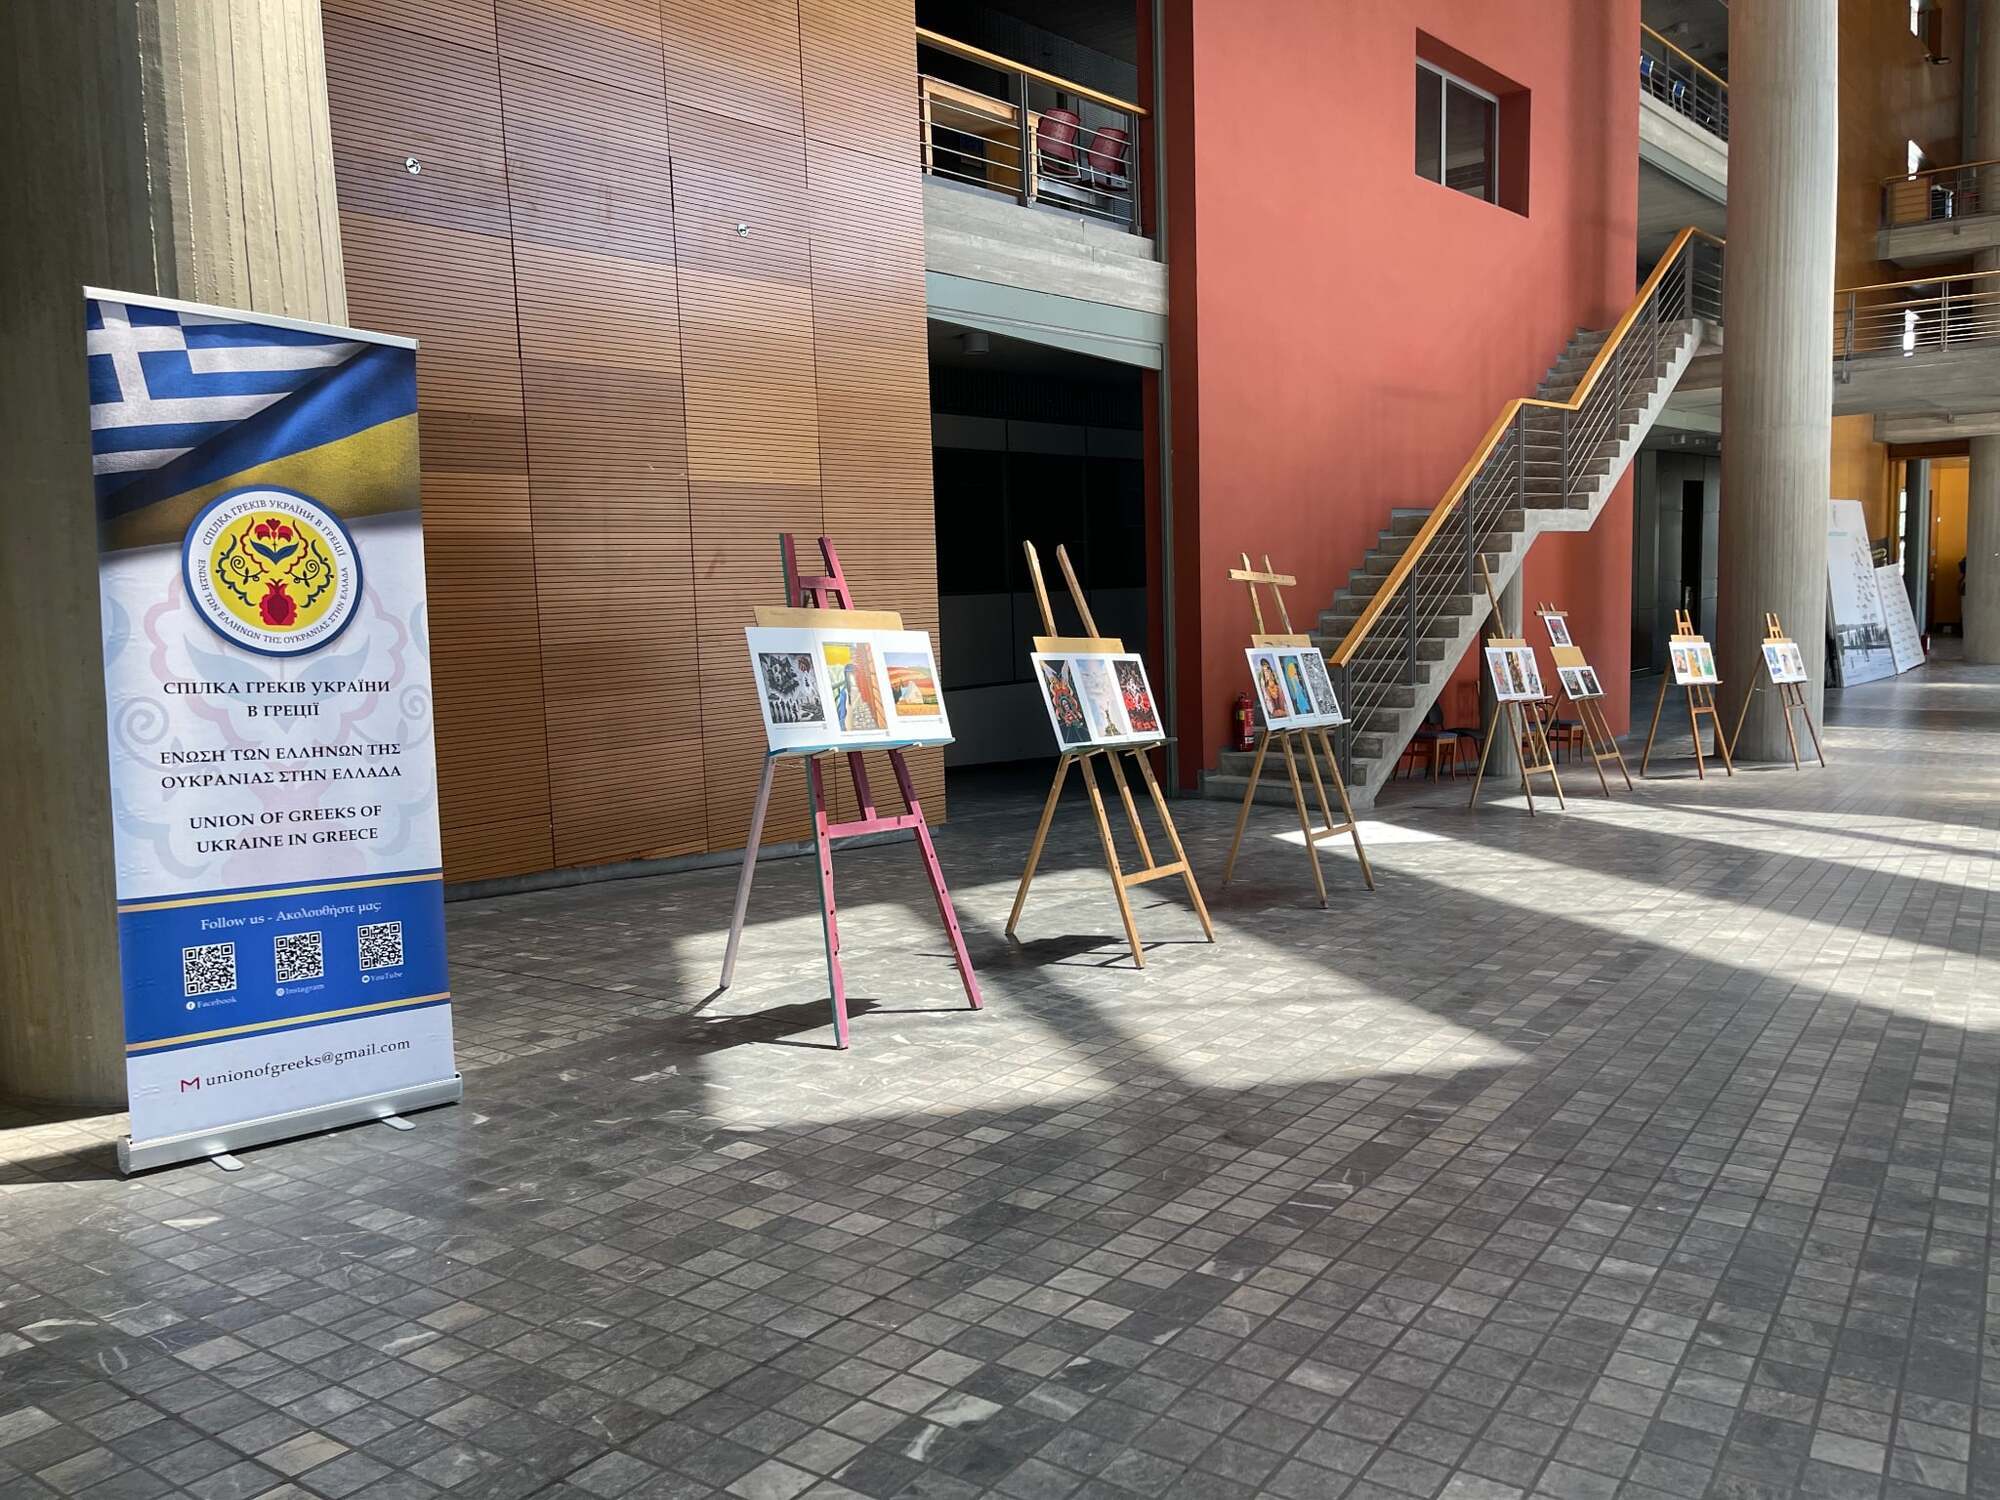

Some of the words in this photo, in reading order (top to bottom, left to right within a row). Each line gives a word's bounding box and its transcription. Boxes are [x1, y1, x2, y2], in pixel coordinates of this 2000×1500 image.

[203, 511, 233, 546] СПІЛКА
[232, 500, 267, 516] ГРЕКІВ
[269, 500, 315, 522] УКРАЇНИ
[315, 519, 322, 527] В
[198, 559, 210, 592] ΕΝΩΣΗ
[205, 592, 221, 612] ΤΩΝ
[217, 612, 261, 641] ΕΛΛΗΝΩΝ
[263, 634, 282, 644] ΤΗΣ
[283, 622, 330, 644] ΟΥΚΡΑΝΙΑΣ
[328, 600, 345, 623] ΣΤΗΝ
[342, 567, 350, 600] ΕΛΛΑΔΑ
[163, 681, 240, 695] СПІЛКА
[246, 681, 306, 694] ГРЕКІВ
[311, 680, 390, 696] УКРАЇНИ
[248, 704, 258, 717] В
[263, 703, 320, 719] ГРЕЦІЇ
[160, 750, 226, 765] ΕΝΩΣΗ
[231, 748, 270, 761] ΤΩΝ
[276, 744, 363, 760] ΕΛΛΗΝΩΝ
[367, 743, 401, 756] ΤΗΣ
[161, 771, 274, 789] ΟΥΚΡΑΝΙΑΣ
[279, 768, 327, 783] ΣΤΗΝ
[333, 765, 401, 780] ΕΛΛΑΔΑ
[190, 813, 255, 829] UNION
[260, 811, 284, 824] OF
[288, 806, 356, 822] GREEKS
[360, 805, 382, 817] OF
[197, 835, 284, 853] UKRAINE
[289, 833, 307, 846] IN
[312, 828, 379, 844] GREECE
[200, 917, 246, 931] Follow
[249, 914, 265, 925] us
[275, 904, 356, 922] Ακολουθήστε
[285, 983, 325, 996] Instagram
[370, 972, 403, 983] YouTube
[197, 996, 237, 1009] Facebook
[205, 1039, 411, 1086] unionofgreeks@gmail.com
